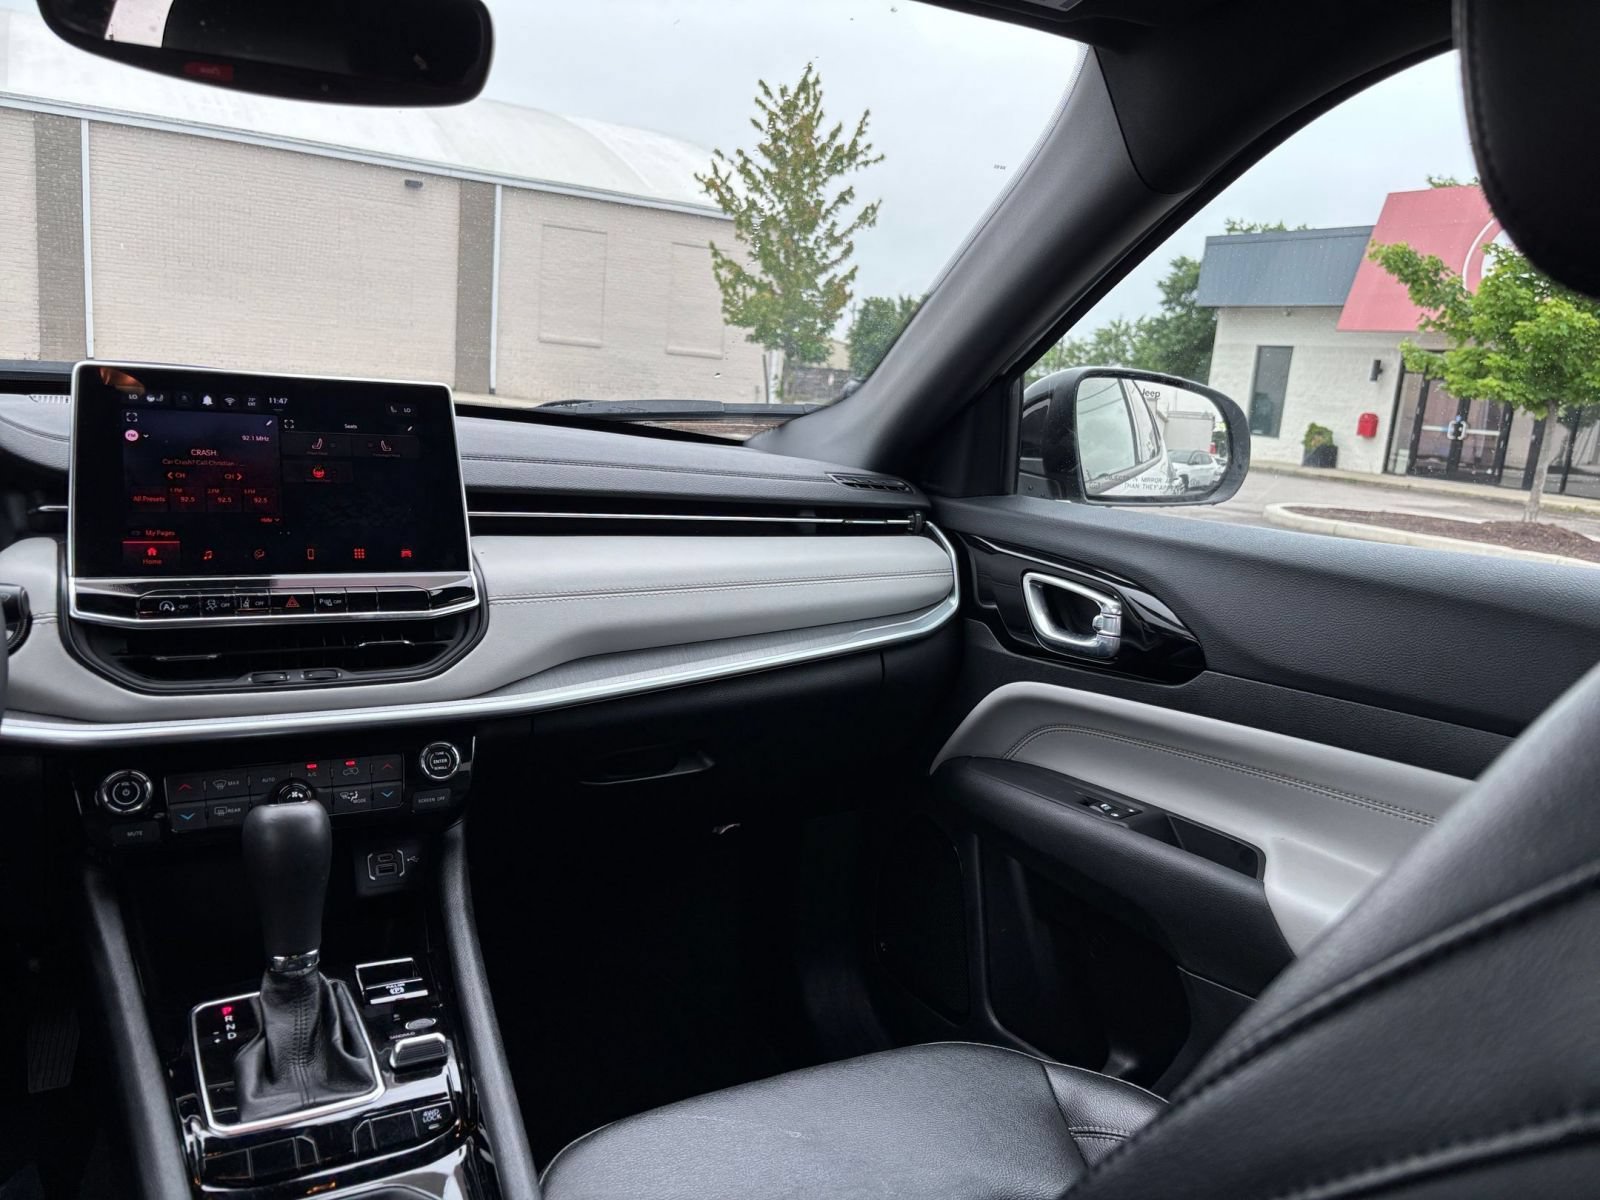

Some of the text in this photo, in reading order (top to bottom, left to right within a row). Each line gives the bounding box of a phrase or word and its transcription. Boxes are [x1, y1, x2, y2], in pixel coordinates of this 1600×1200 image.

[1141, 388, 1161, 398] Jeep
[268, 396, 288, 404] 11:47
[222, 1007, 232, 1015] P
[225, 1023, 236, 1031] N
[227, 1031, 237, 1040] D
[422, 1108, 440, 1117] 4WD
[422, 1113, 443, 1123] LOCK
